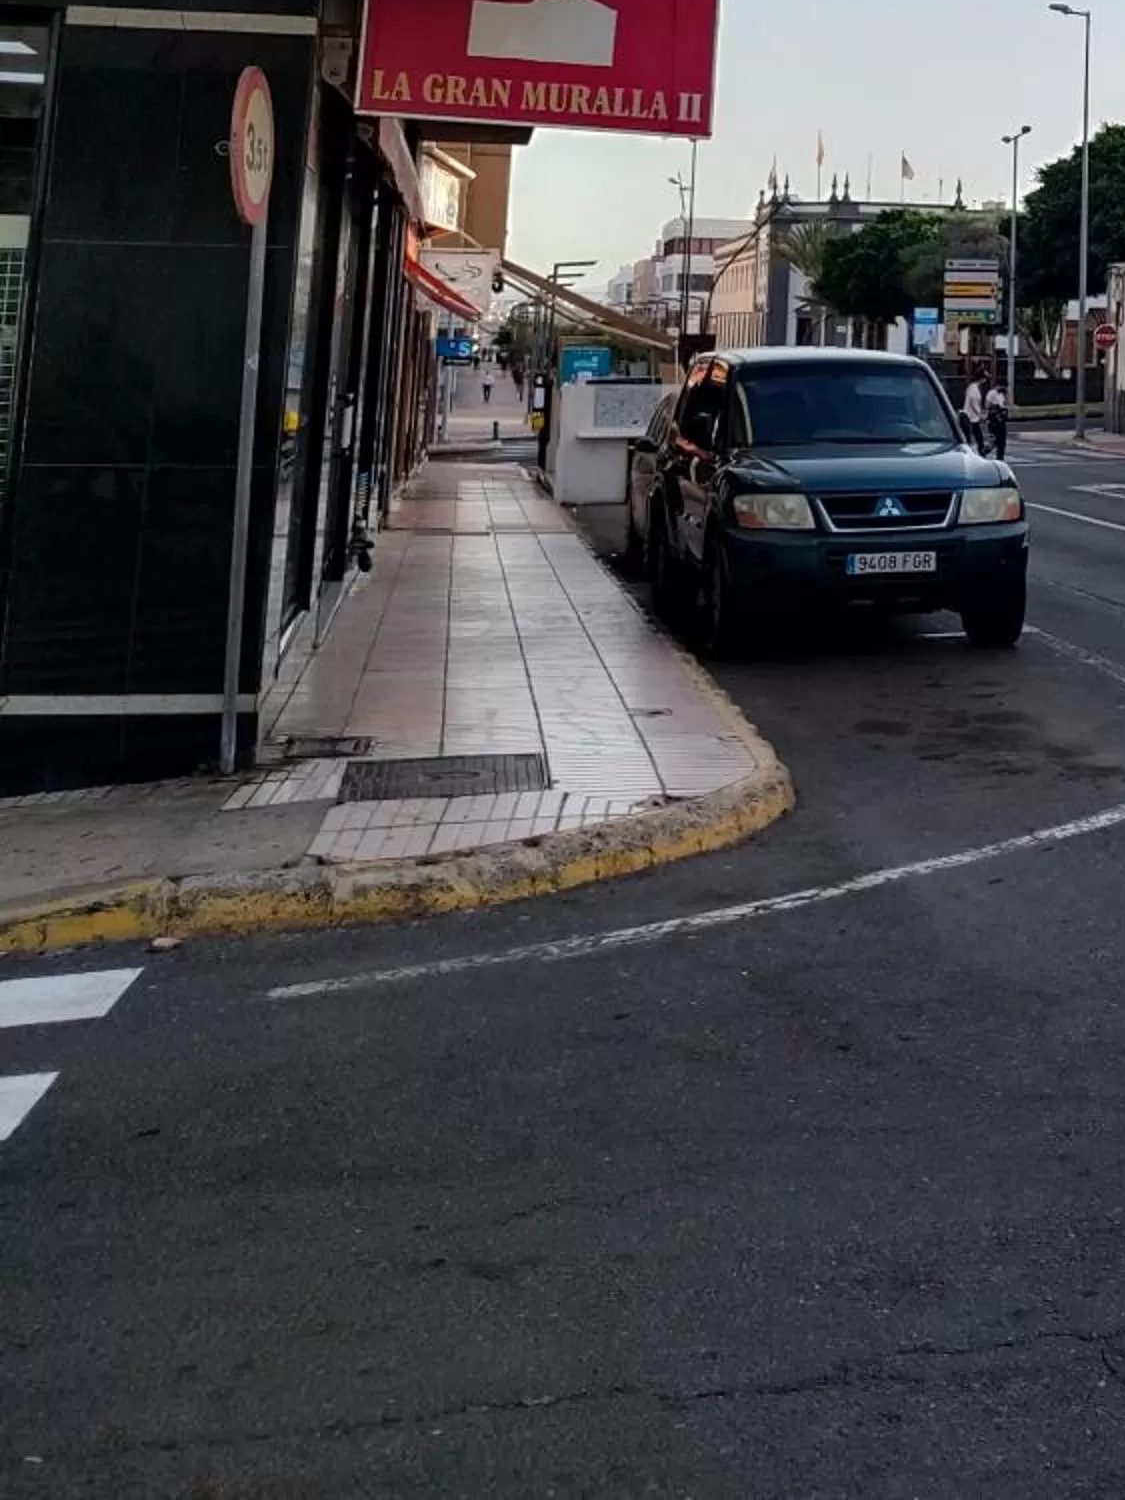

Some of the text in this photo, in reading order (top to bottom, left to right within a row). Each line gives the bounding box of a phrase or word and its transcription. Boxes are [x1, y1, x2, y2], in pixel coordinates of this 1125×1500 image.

[372, 69, 704, 122] LA GRAN MURALLA II
[858, 553, 932, 571] 9408 FGR
